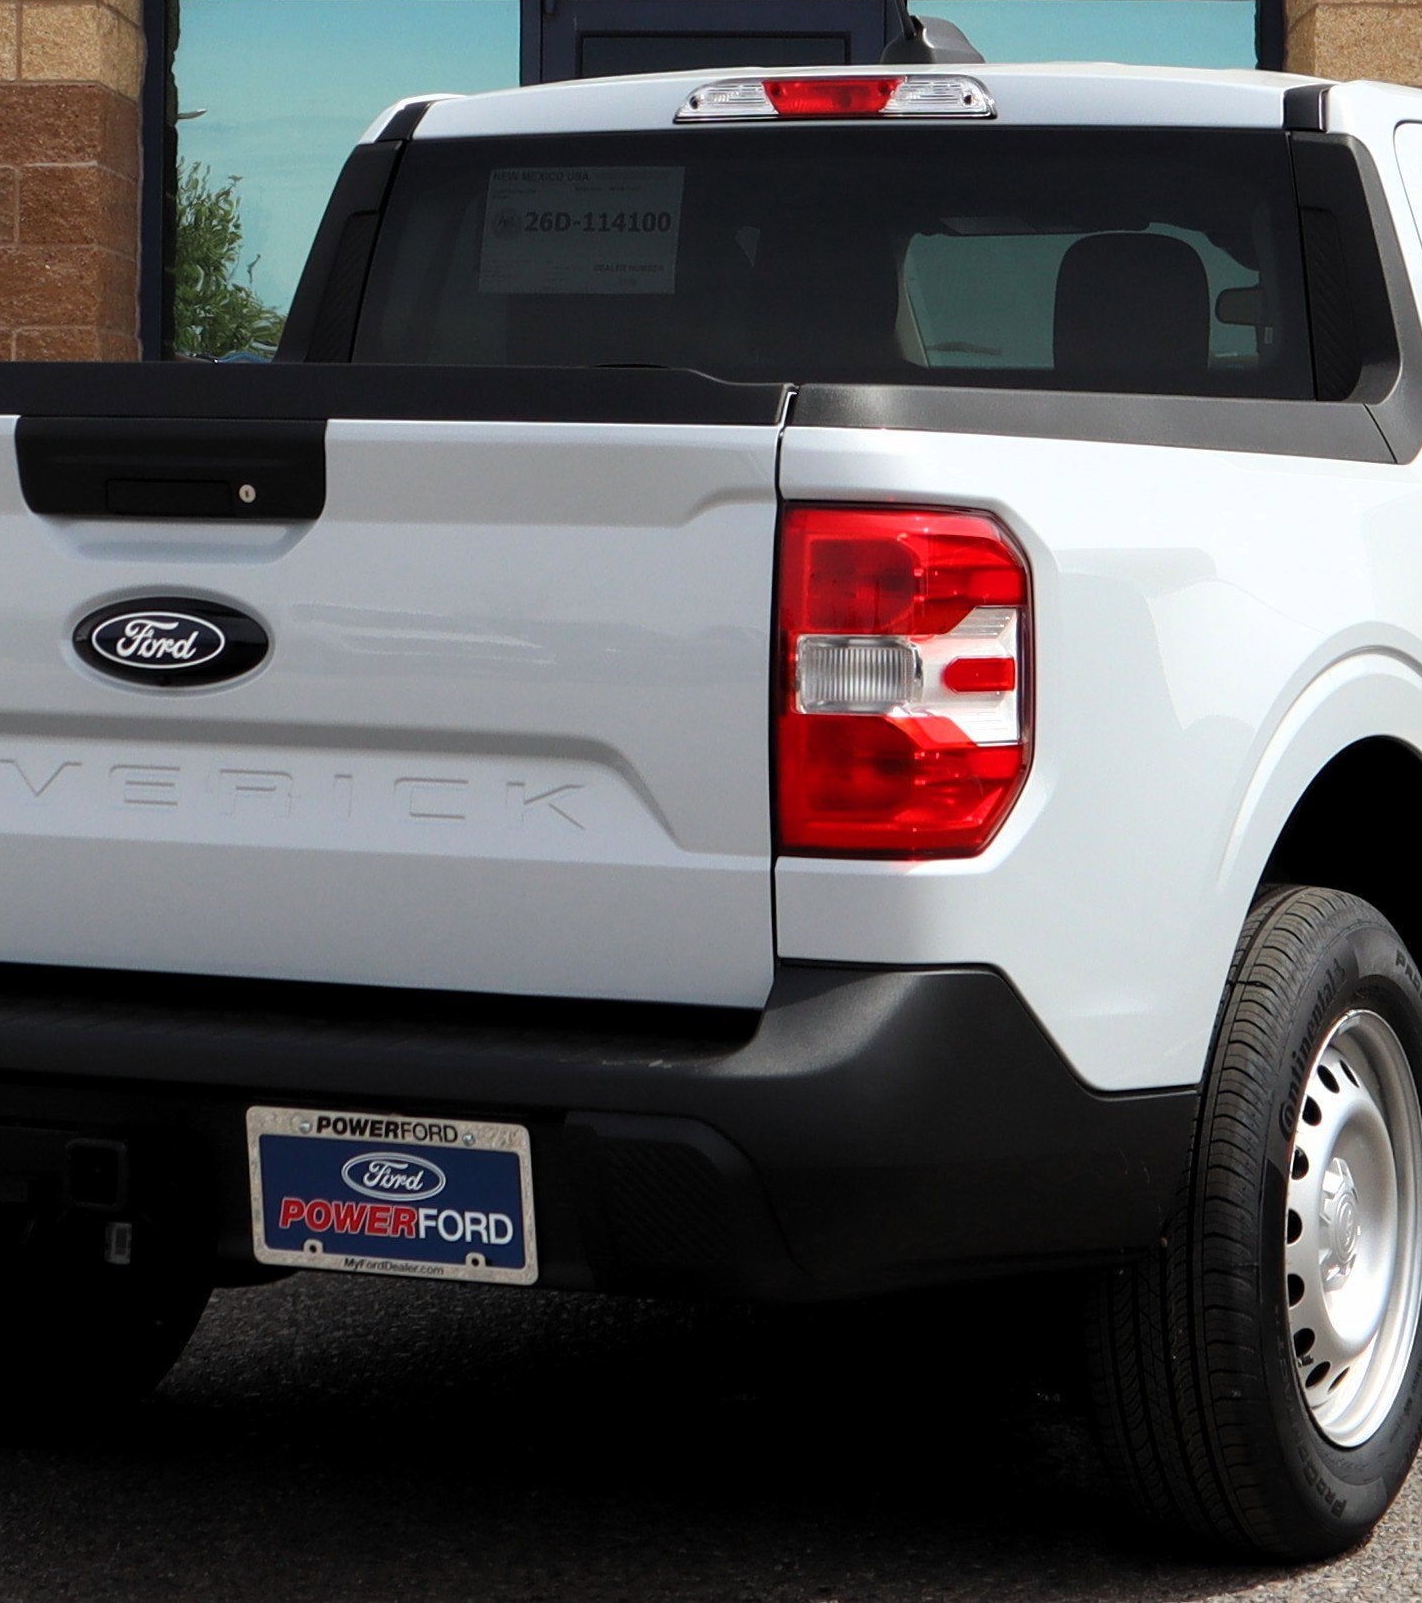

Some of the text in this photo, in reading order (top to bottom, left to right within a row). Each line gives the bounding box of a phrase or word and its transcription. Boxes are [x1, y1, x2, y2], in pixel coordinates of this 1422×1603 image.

[524, 211, 672, 234] 26D-114100
[114, 615, 202, 662] Ford
[316, 1115, 458, 1144] POWERFORD
[362, 1159, 425, 1192] Ford
[279, 1196, 515, 1246] POWERFORD
[343, 1257, 445, 1276] MyFordDealer.com
